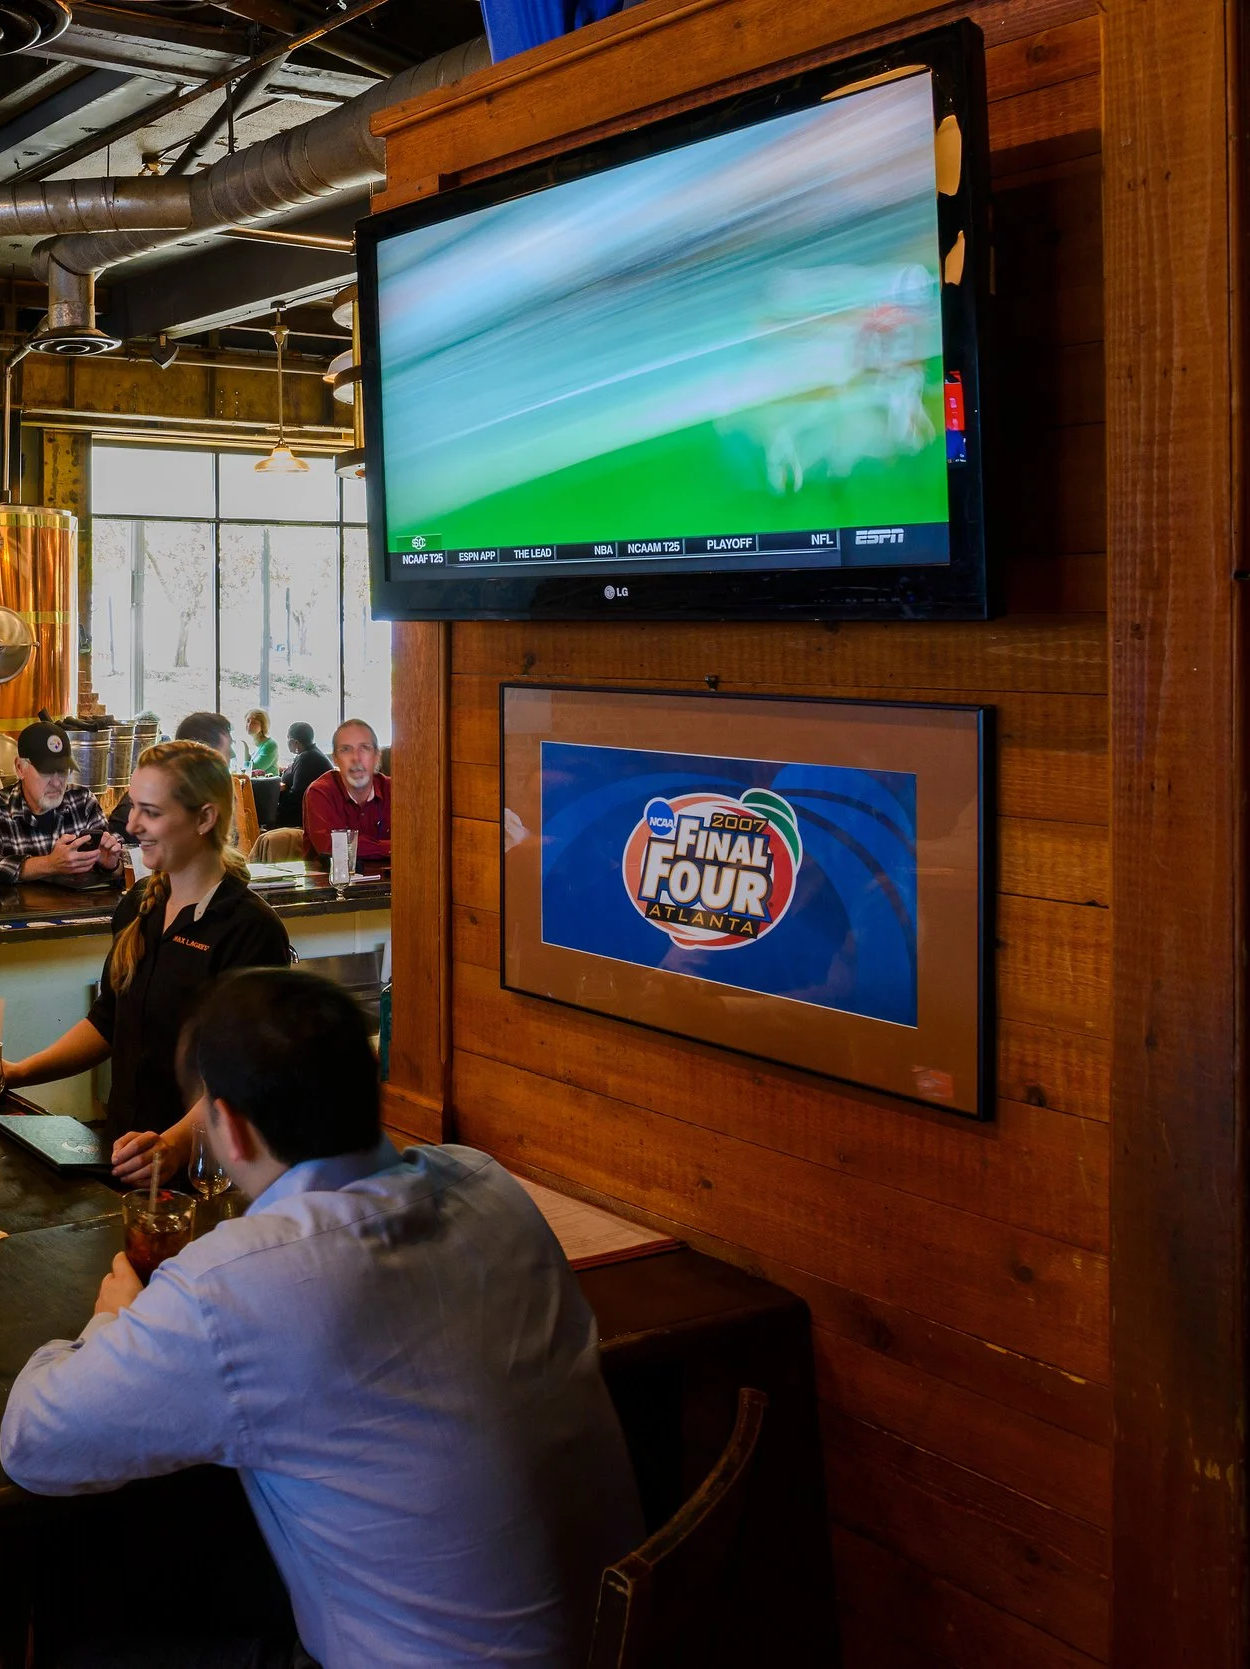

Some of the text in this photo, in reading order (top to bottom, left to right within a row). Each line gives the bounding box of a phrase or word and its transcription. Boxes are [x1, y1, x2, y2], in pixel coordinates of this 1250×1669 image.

[811, 533, 834, 546] NFL
[855, 528, 905, 545] ESPN
[627, 541, 680, 554] NCAAM T25
[706, 537, 753, 550] PLAYOFF
[459, 551, 496, 562] ESPN APP
[513, 548, 552, 559] THE LEAD
[594, 545, 614, 556] NBA
[402, 553, 444, 565] NCAAF T25
[616, 587, 629, 597] LG
[650, 816, 675, 830] NCAA
[711, 815, 767, 833] 2007
[676, 817, 768, 868] FINAL
[641, 841, 765, 917] FOUR
[648, 906, 754, 935] ATLANTA
